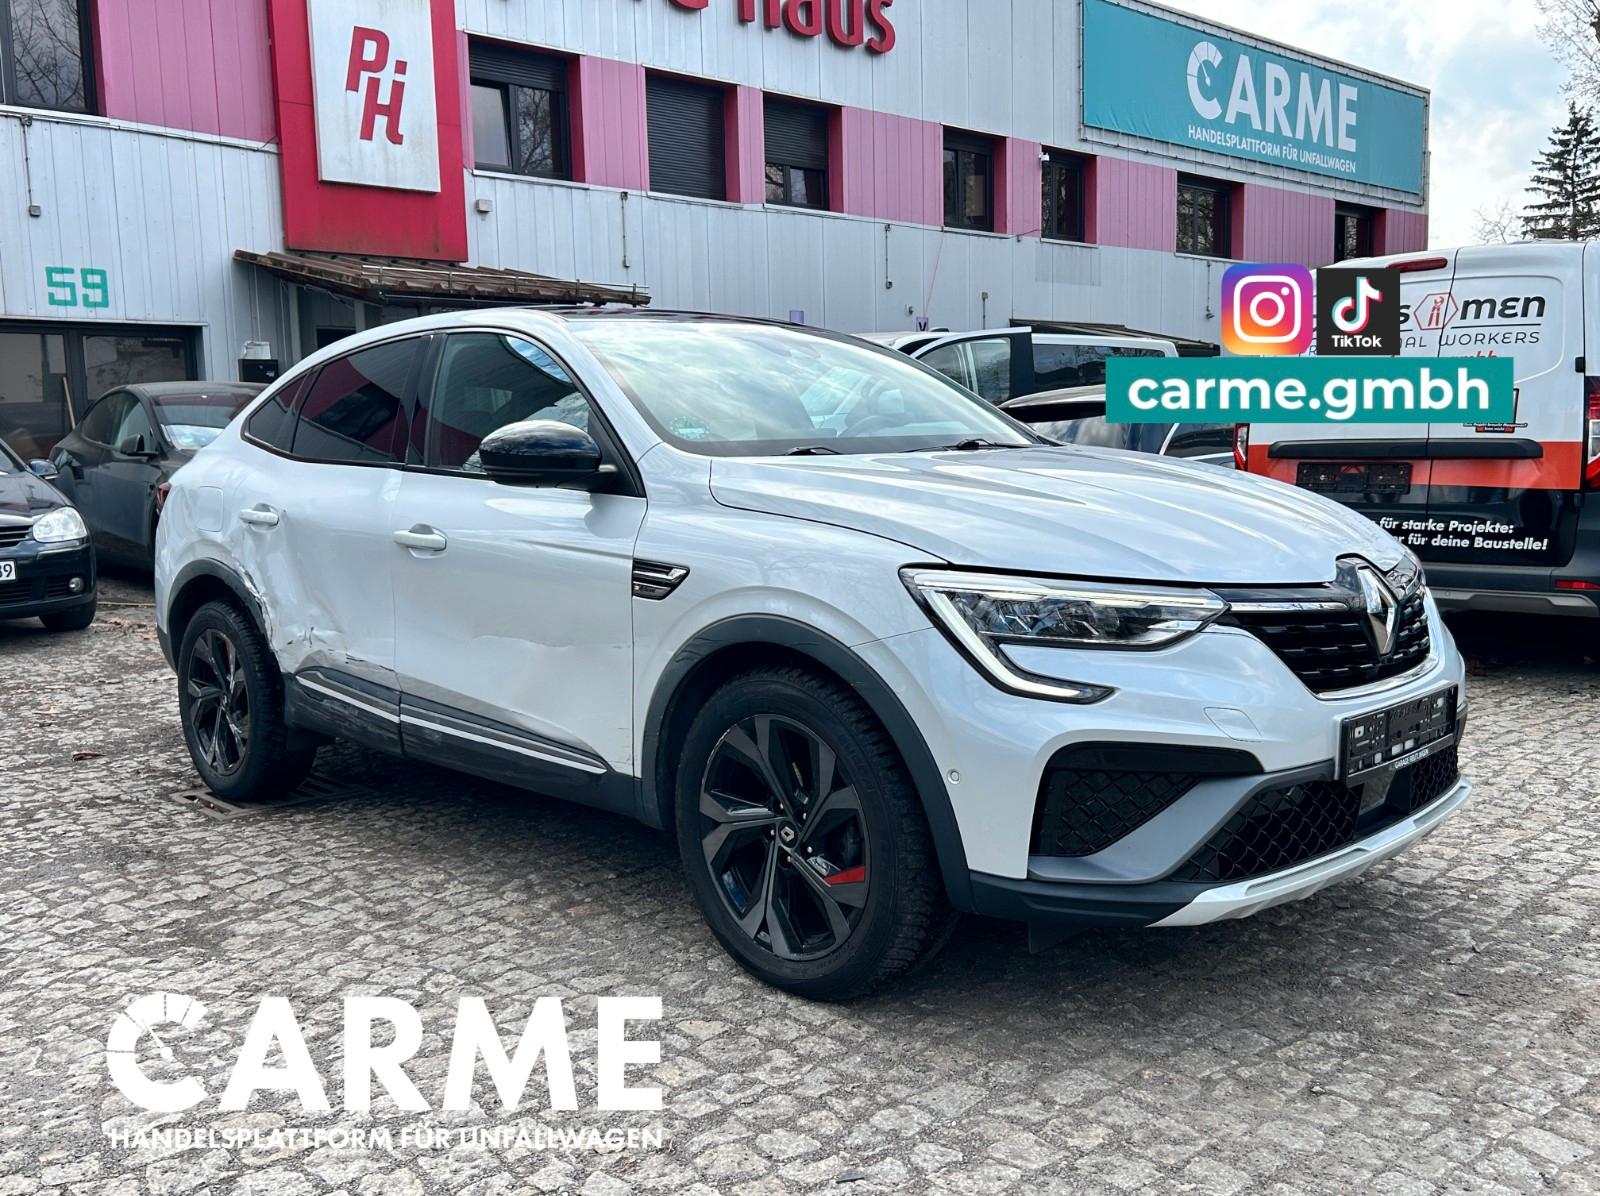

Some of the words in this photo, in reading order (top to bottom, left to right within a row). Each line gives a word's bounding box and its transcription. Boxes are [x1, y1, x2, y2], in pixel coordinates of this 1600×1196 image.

[1187, 41, 1358, 152] CARME
[1188, 125, 1280, 156] HANDELSPLATTFORM
[1283, 144, 1298, 161] FÜR
[1300, 151, 1356, 173] UNFALLWAGEN
[44, 266, 109, 309] 59
[1440, 331, 1540, 347] WORKERS
[1379, 516, 1399, 529] für
[1402, 518, 1445, 532] starke
[1448, 520, 1514, 535] Projekte:
[1407, 533, 1428, 545] für
[1431, 534, 1470, 548] deine
[1473, 536, 1548, 550] Baustelle!
